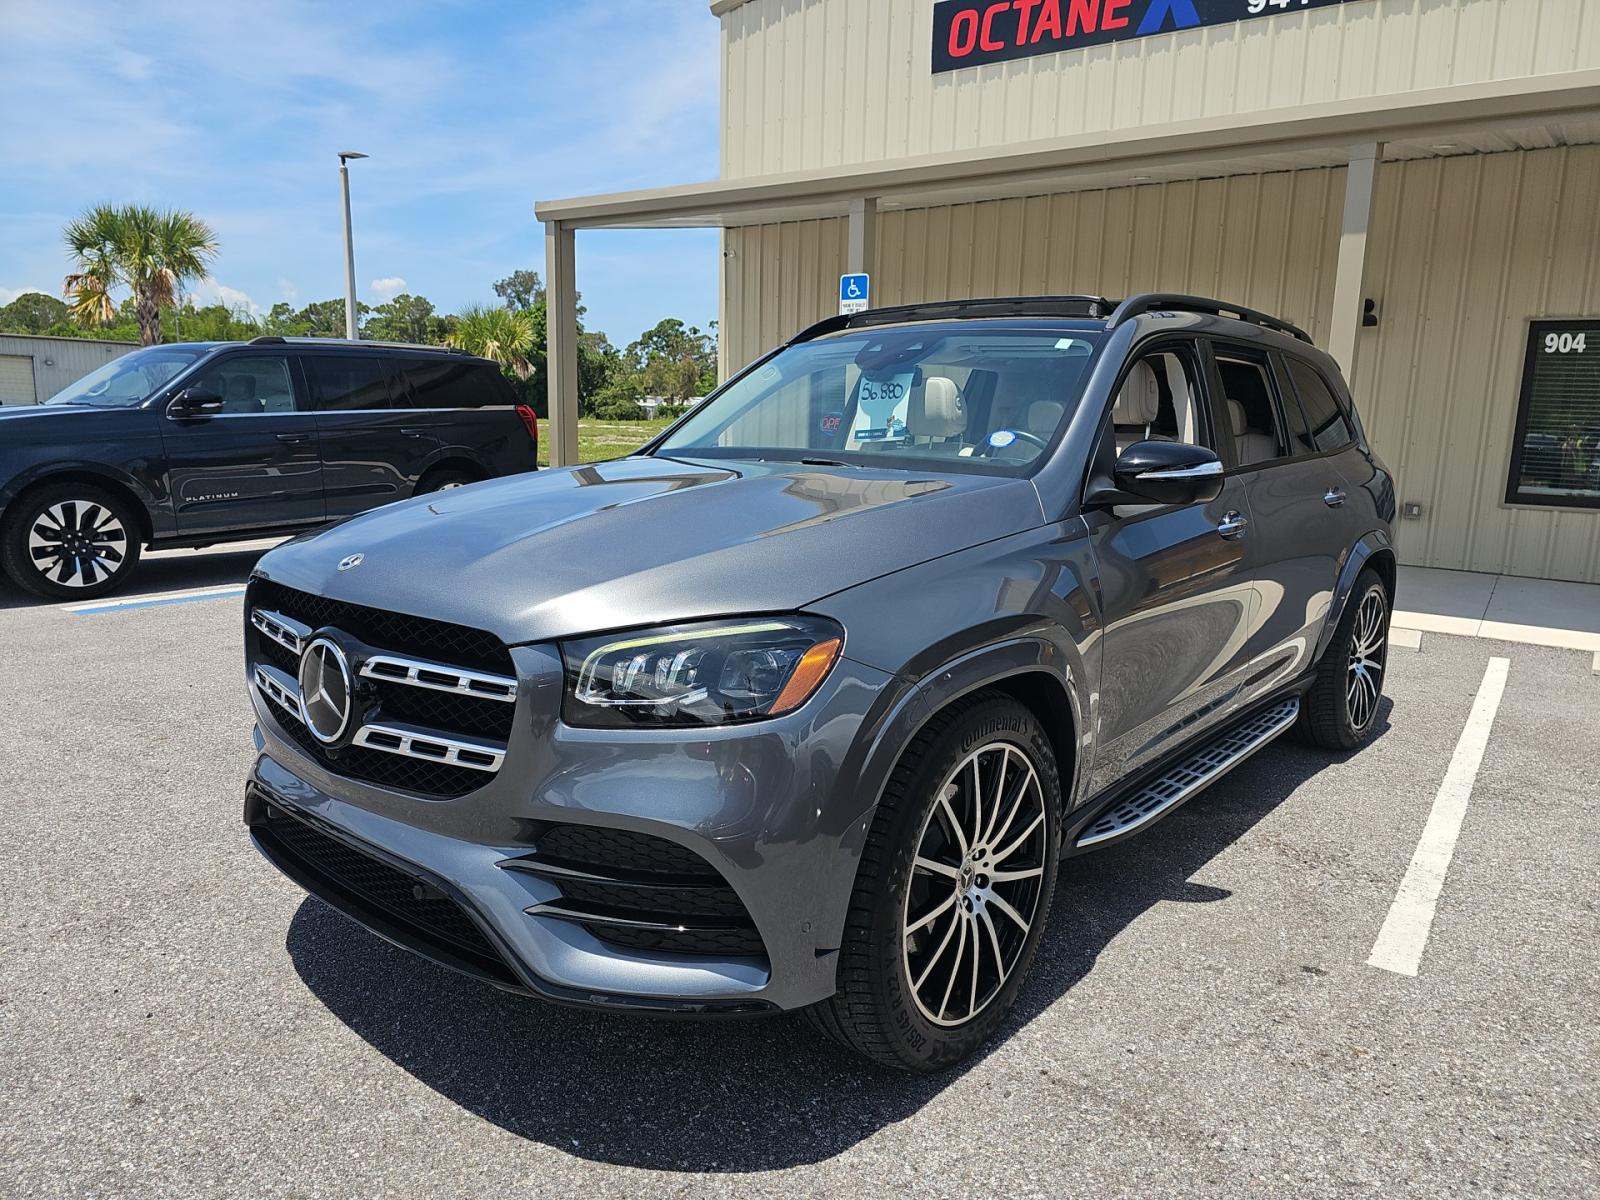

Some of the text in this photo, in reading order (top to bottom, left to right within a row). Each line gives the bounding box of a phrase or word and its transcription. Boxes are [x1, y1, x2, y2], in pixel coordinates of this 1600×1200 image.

[1544, 333, 1587, 353] 904
[185, 492, 239, 502] PLATINUM
[962, 716, 1022, 753] Continental
[895, 1009, 927, 1053] 285/45
